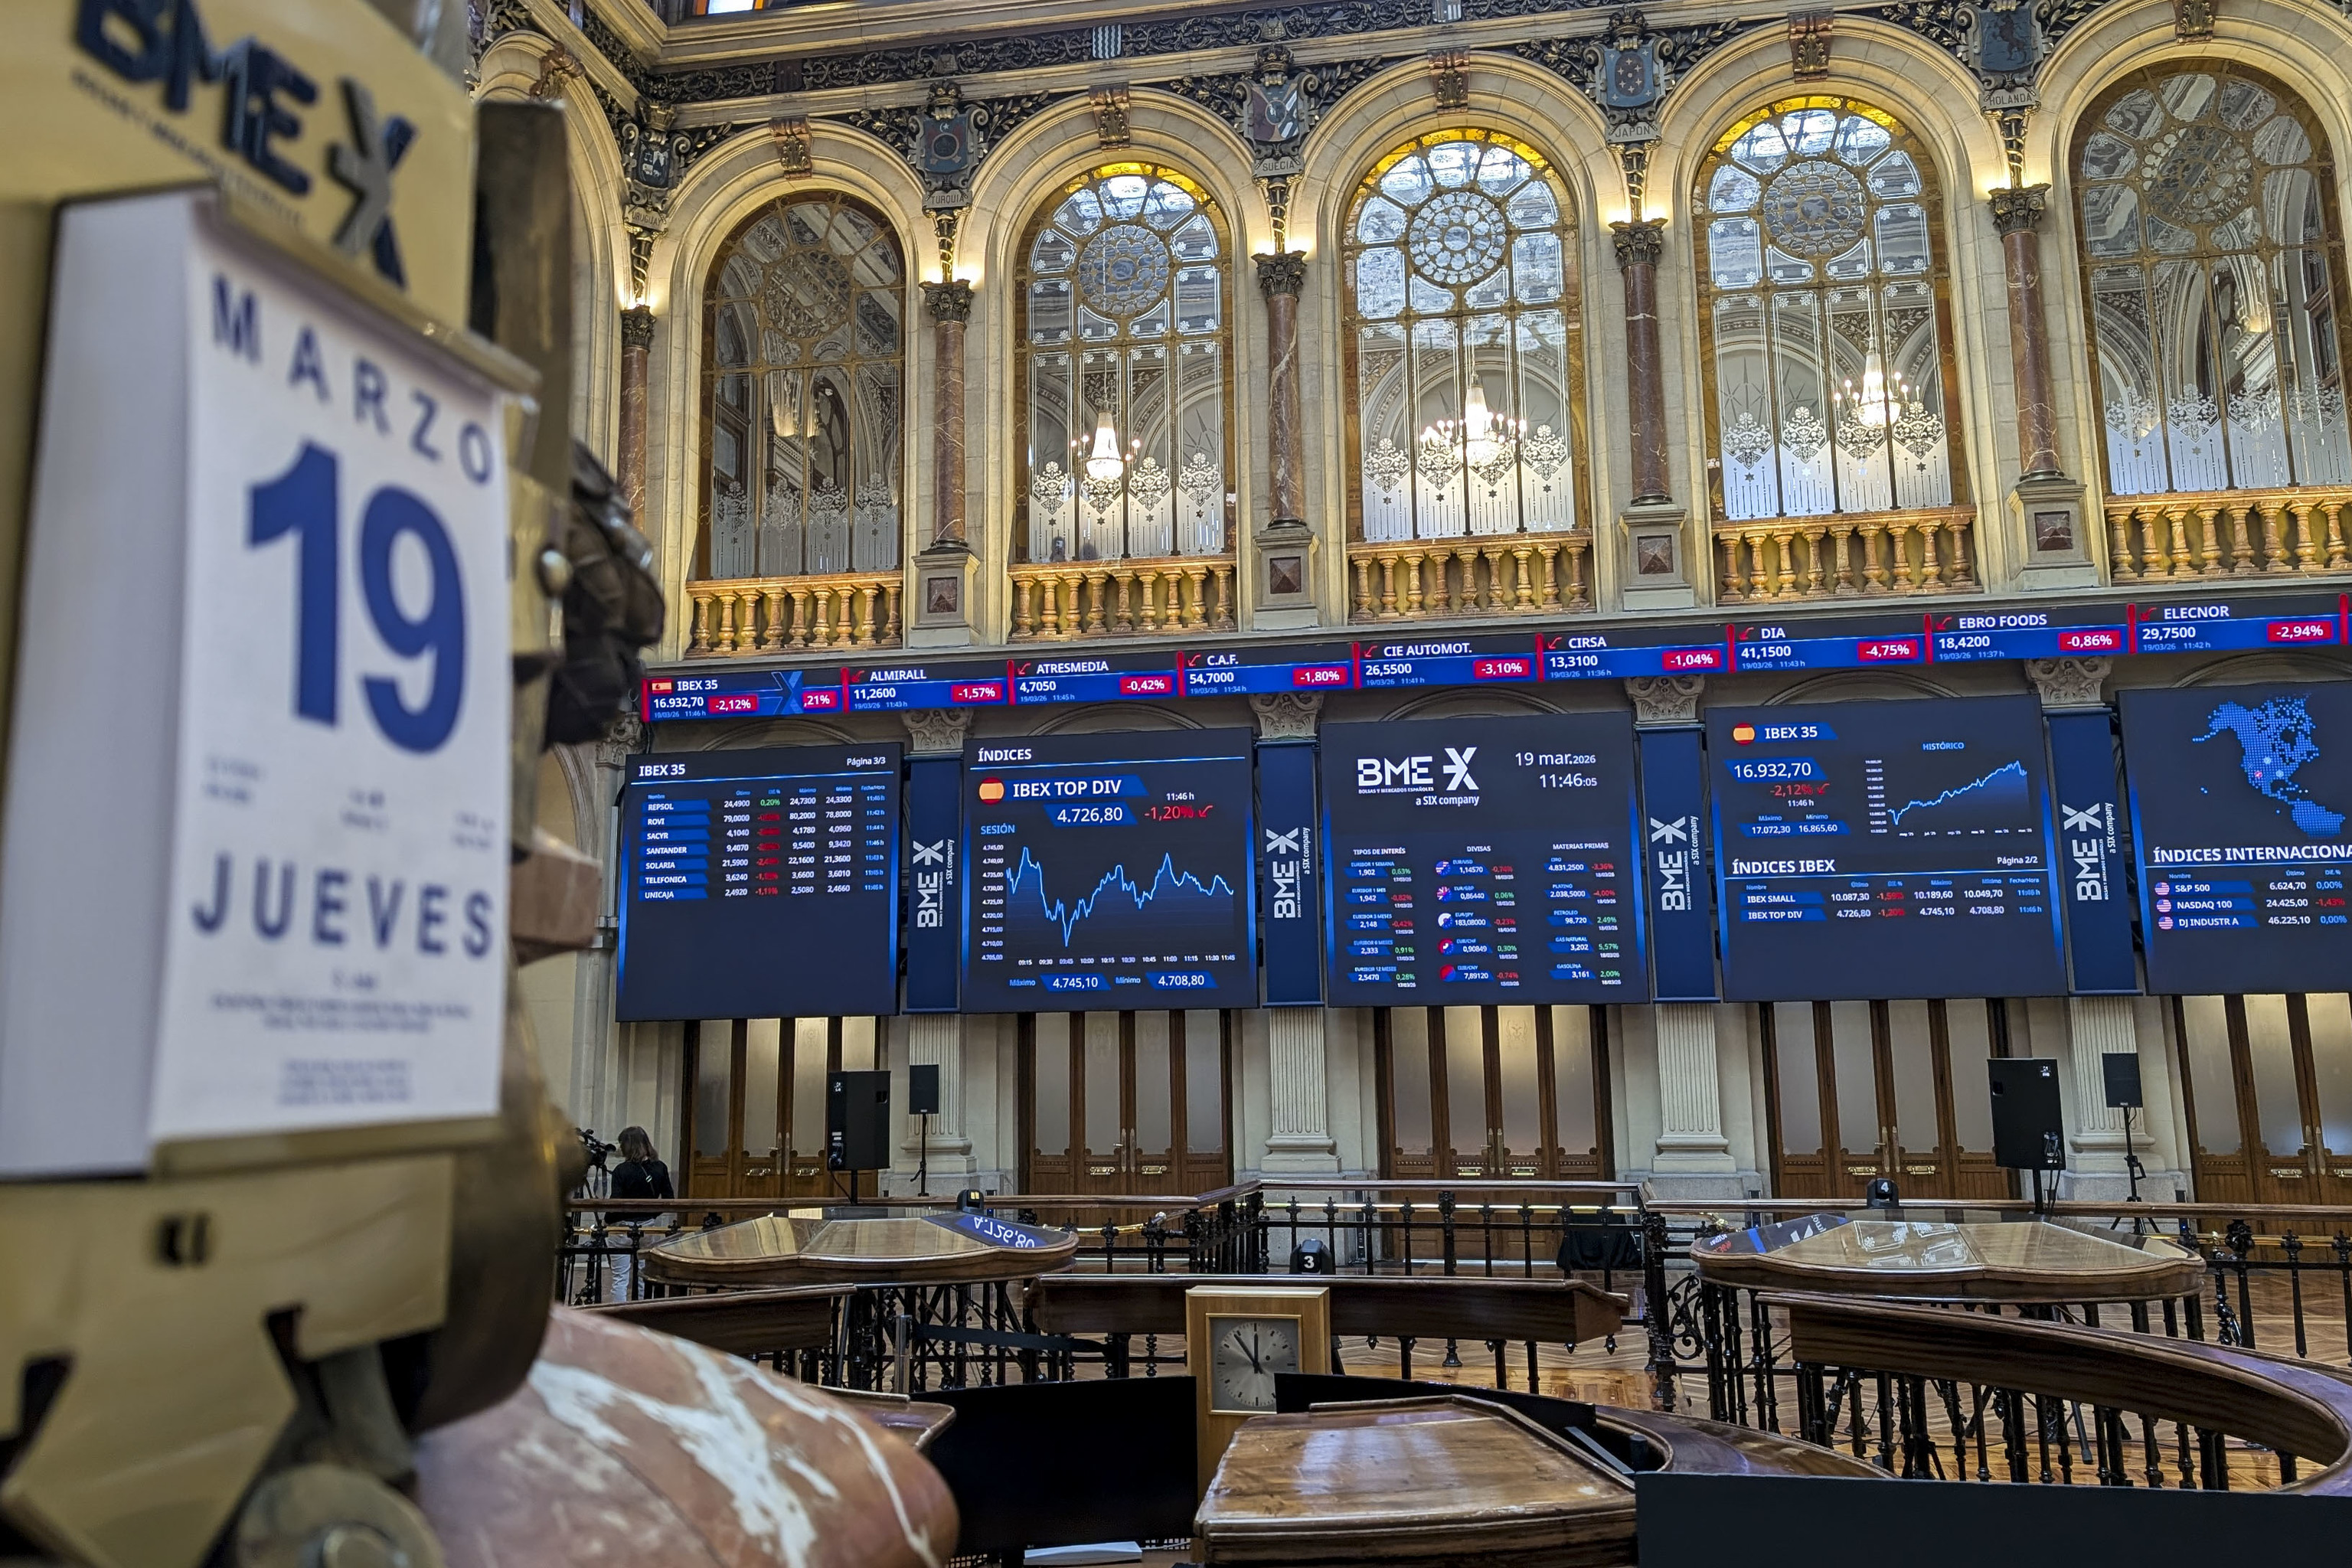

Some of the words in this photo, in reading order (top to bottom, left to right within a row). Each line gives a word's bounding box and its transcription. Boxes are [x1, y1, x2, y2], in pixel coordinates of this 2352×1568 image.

[1990, 93, 2031, 106] HOLANDA
[1615, 126, 1650, 138] JAPON
[1263, 161, 1295, 172] SUECIA
[931, 194, 965, 204] TURQUIA
[632, 212, 662, 226] URUGUAY
[213, 274, 493, 485] MARZO
[246, 436, 467, 754] 19
[2164, 606, 2230, 619] ELECNOR
[1959, 617, 1995, 629] EBRO
[2000, 614, 2047, 627] FOODS
[1762, 628, 1785, 639] DIA
[2142, 627, 2196, 640] 29,7500
[2276, 626, 2323, 639] -2,94%
[1569, 637, 1606, 648] CIRSA
[1939, 636, 1990, 649] 18,4200
[2067, 635, 2112, 648] -0,86%
[1383, 645, 1403, 656] CIE
[1406, 643, 1472, 655] AUTOMOT.
[1741, 646, 1791, 659] 41,1500
[1866, 645, 1909, 657] -4,75%
[1207, 655, 1239, 665] C.A.F.
[1550, 655, 1598, 668] 13,3100
[1671, 654, 1713, 666] -1,04%
[1037, 661, 1109, 674] ATRESMEDIA
[1366, 664, 1412, 676] 26,5500
[1481, 663, 1522, 675] -3,10%
[870, 670, 926, 681] ALMIRALL
[1189, 672, 1234, 684] 54,7000
[1300, 671, 1339, 683] -1,80%
[677, 681, 703, 691] IBEX
[705, 680, 718, 690] 35
[1020, 681, 1056, 693] 4,7050
[1127, 680, 1165, 691] -0,42%
[854, 688, 896, 700] 11,2600
[959, 688, 995, 698] -1,57%
[654, 697, 704, 708] 16.932,70
[716, 700, 751, 711] -2,12%
[1765, 727, 1798, 739] IBEX
[1801, 727, 1818, 737] 35
[1922, 742, 1965, 750] HISTÓRICO
[978, 747, 1031, 762] ÍNDICES
[1515, 753, 1534, 766] 19
[639, 765, 668, 776] IBEX
[671, 764, 685, 775] 35
[847, 759, 871, 767] Página
[1357, 756, 1433, 786] BME
[1734, 763, 1811, 779] 16.932,70
[1540, 773, 1597, 788] 11:46:05
[1013, 782, 1050, 797] IBEX
[1054, 782, 1087, 795] TOP
[1093, 779, 1122, 794] DIV
[1770, 784, 1813, 797] -2,12%
[1423, 795, 1437, 805] SIX
[1439, 795, 1479, 806] company
[1057, 807, 1122, 823] 4.726,80
[1145, 805, 1194, 821] -1,20%
[2105, 802, 2115, 835] company
[793, 826, 815, 835] 4,1780
[981, 823, 1015, 835] SESIÓN
[1690, 816, 1699, 847] company
[1752, 826, 1791, 835] 17.072,30
[1799, 824, 1838, 833] 16.865,60
[2107, 836, 2115, 848] SIX
[946, 839, 955, 868] company
[2154, 847, 2221, 862] ÍNDICES
[1733, 858, 1795, 874] ÍNDICES
[1799, 859, 1835, 873] IBEX
[1998, 857, 2024, 866] Página
[2269, 882, 2306, 890] 6.624,70
[2316, 881, 2342, 890] 0,00%
[645, 891, 674, 900] UNICAJA
[1831, 893, 1869, 902] 10.087,30
[1914, 891, 1953, 900] 10.189,60
[1964, 890, 2003, 898] 10.049,70
[192, 851, 495, 960] JUEVES
[2177, 901, 2214, 910] NASDAQ
[2266, 899, 2308, 908] 24.425,00
[1837, 910, 1870, 919] 4.726,80
[1920, 907, 1955, 916] 4.745,10
[1969, 906, 2004, 915] 4.708,80
[2179, 920, 2188, 928] DJ
[2269, 916, 2310, 925] 46.225,10
[2320, 916, 2347, 924] 0,00%
[1053, 978, 1098, 988] 4.745,10
[1158, 975, 1204, 986] 4.708,80
[1880, 1182, 1889, 1192] 4
[1304, 1256, 1315, 1268] 3
